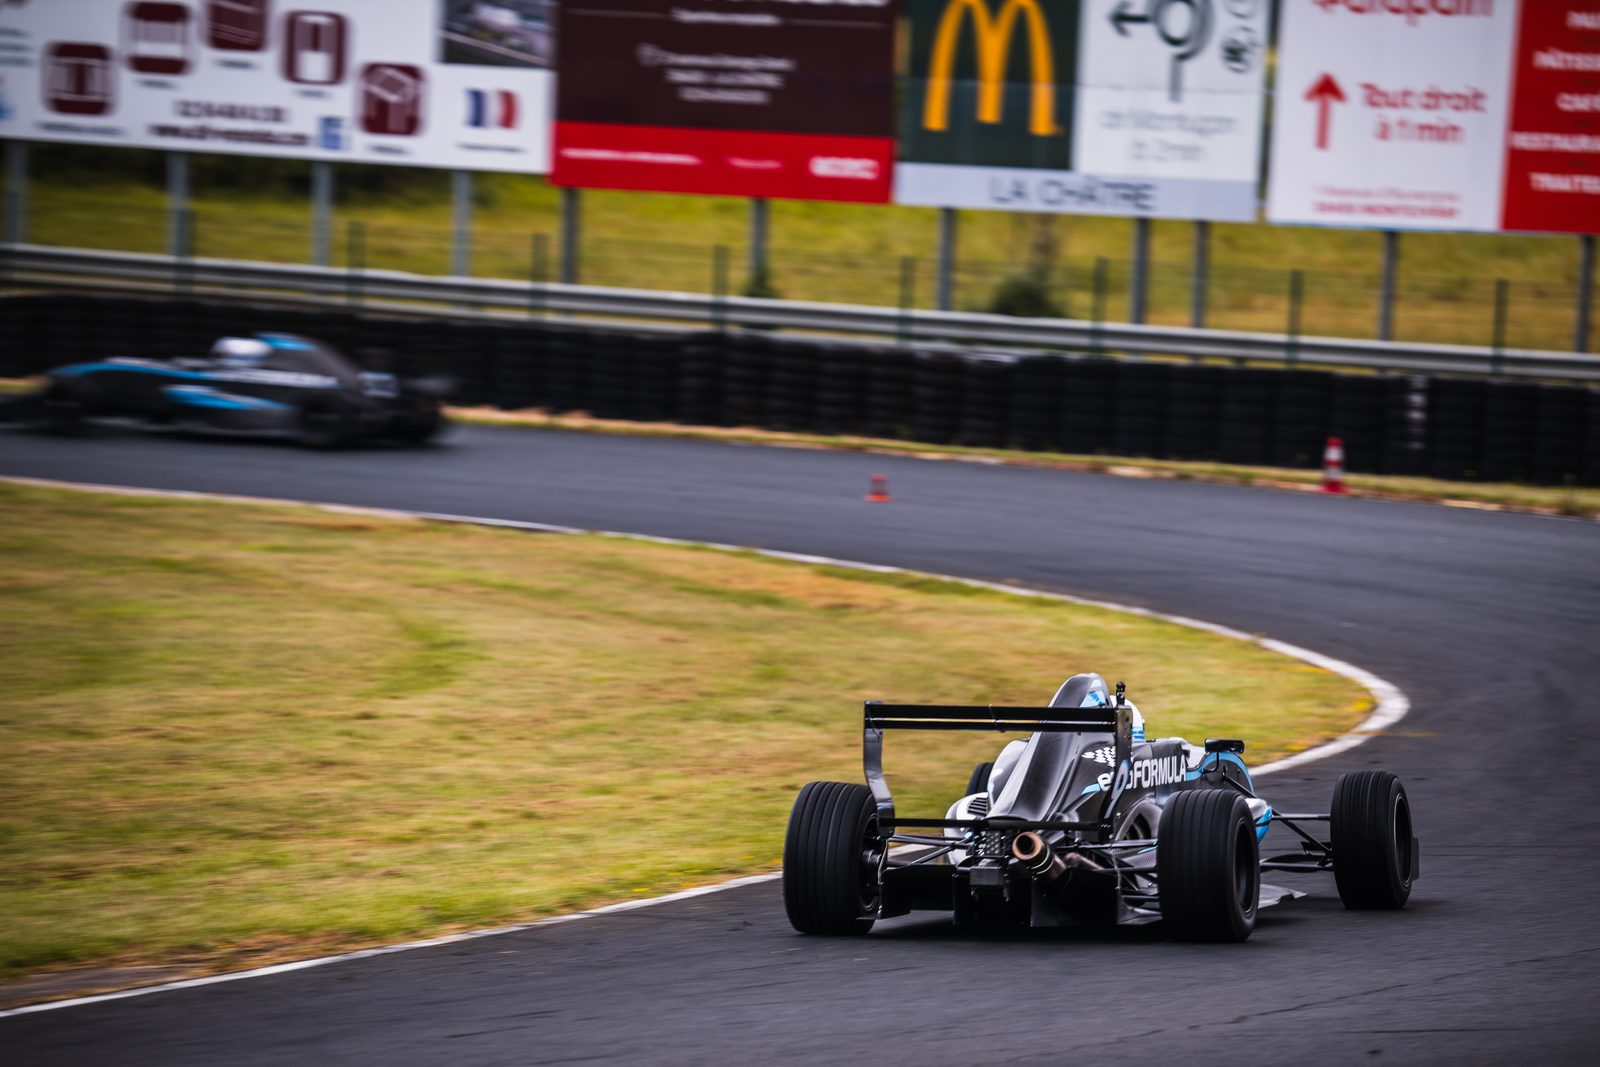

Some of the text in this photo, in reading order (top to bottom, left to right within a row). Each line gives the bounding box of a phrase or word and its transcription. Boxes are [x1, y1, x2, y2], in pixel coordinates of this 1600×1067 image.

[1358, 82, 1488, 113] Tout droit
[988, 176, 1028, 204] LA
